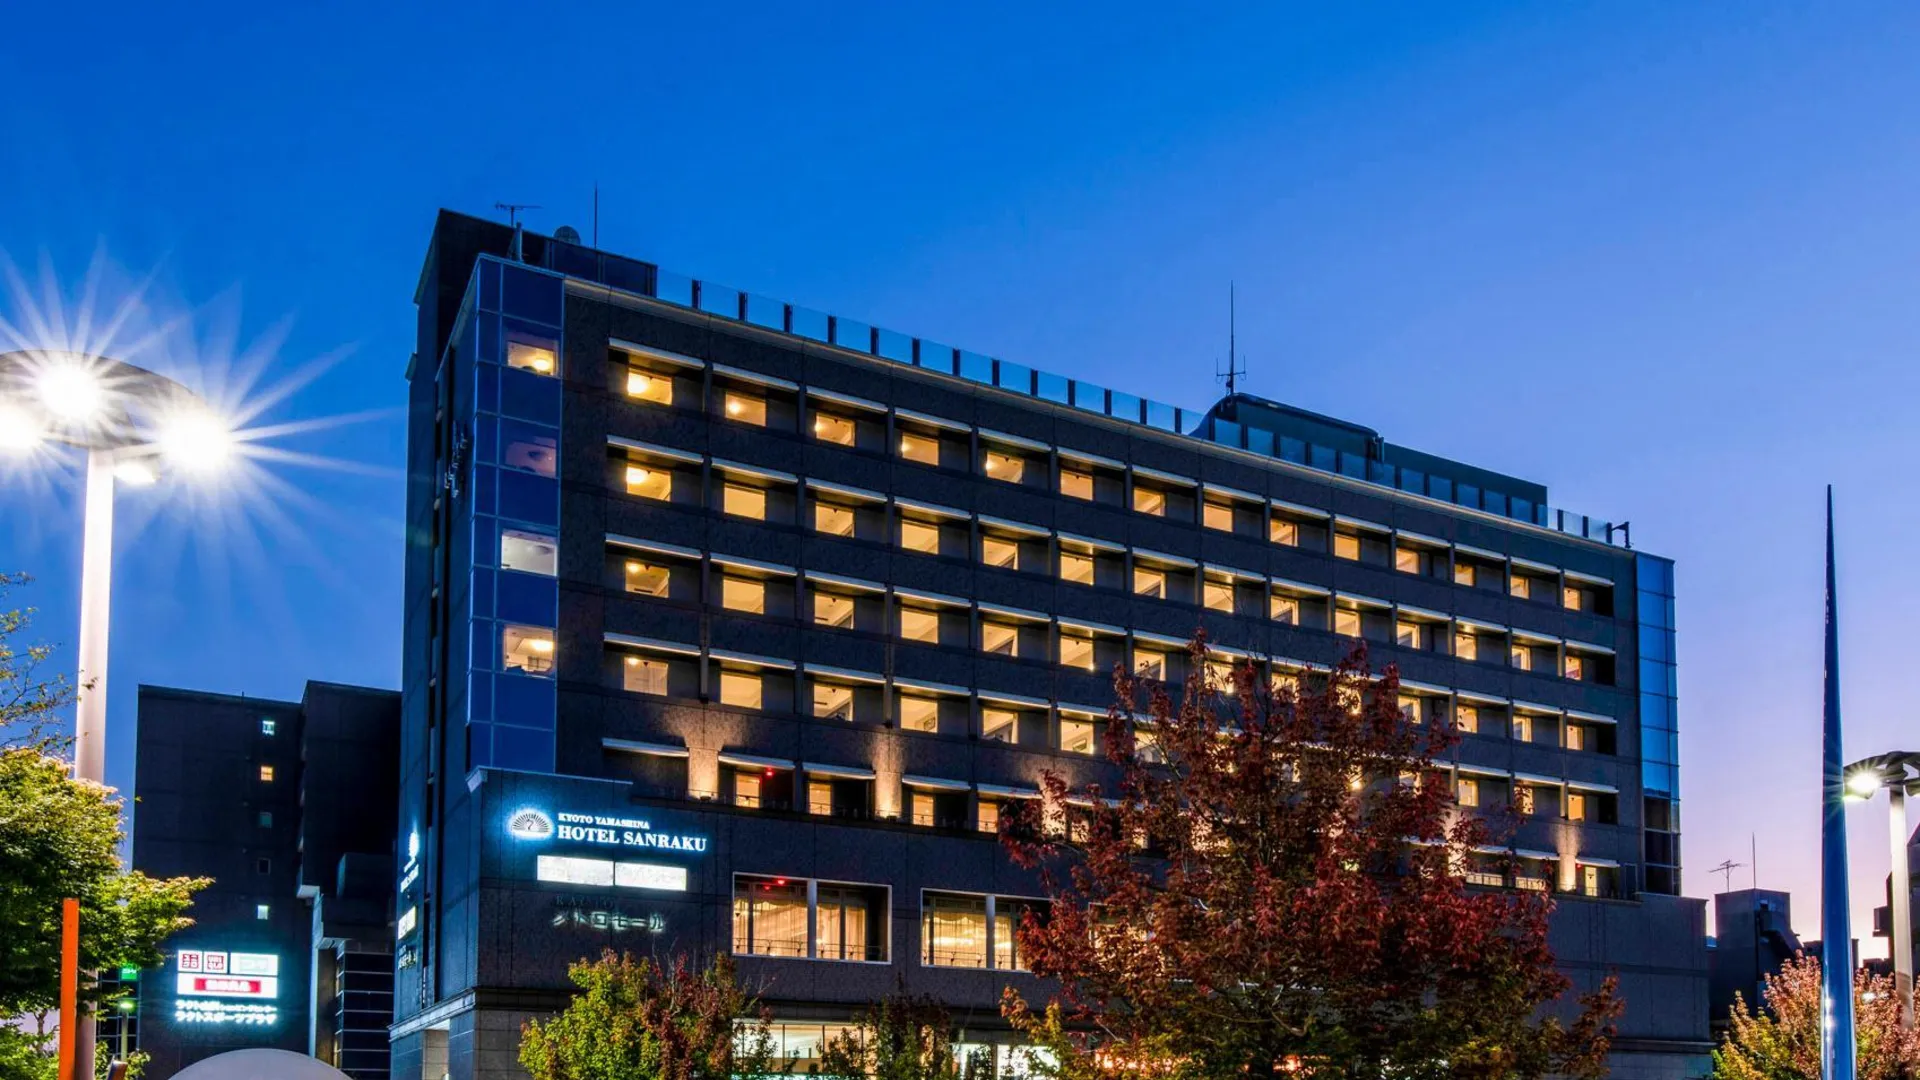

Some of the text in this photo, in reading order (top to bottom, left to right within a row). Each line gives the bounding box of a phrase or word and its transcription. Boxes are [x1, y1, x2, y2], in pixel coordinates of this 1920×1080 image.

[558, 812, 650, 829] KYOTO YAMASHINA
[557, 824, 707, 851] HOTEL SANRAKU
